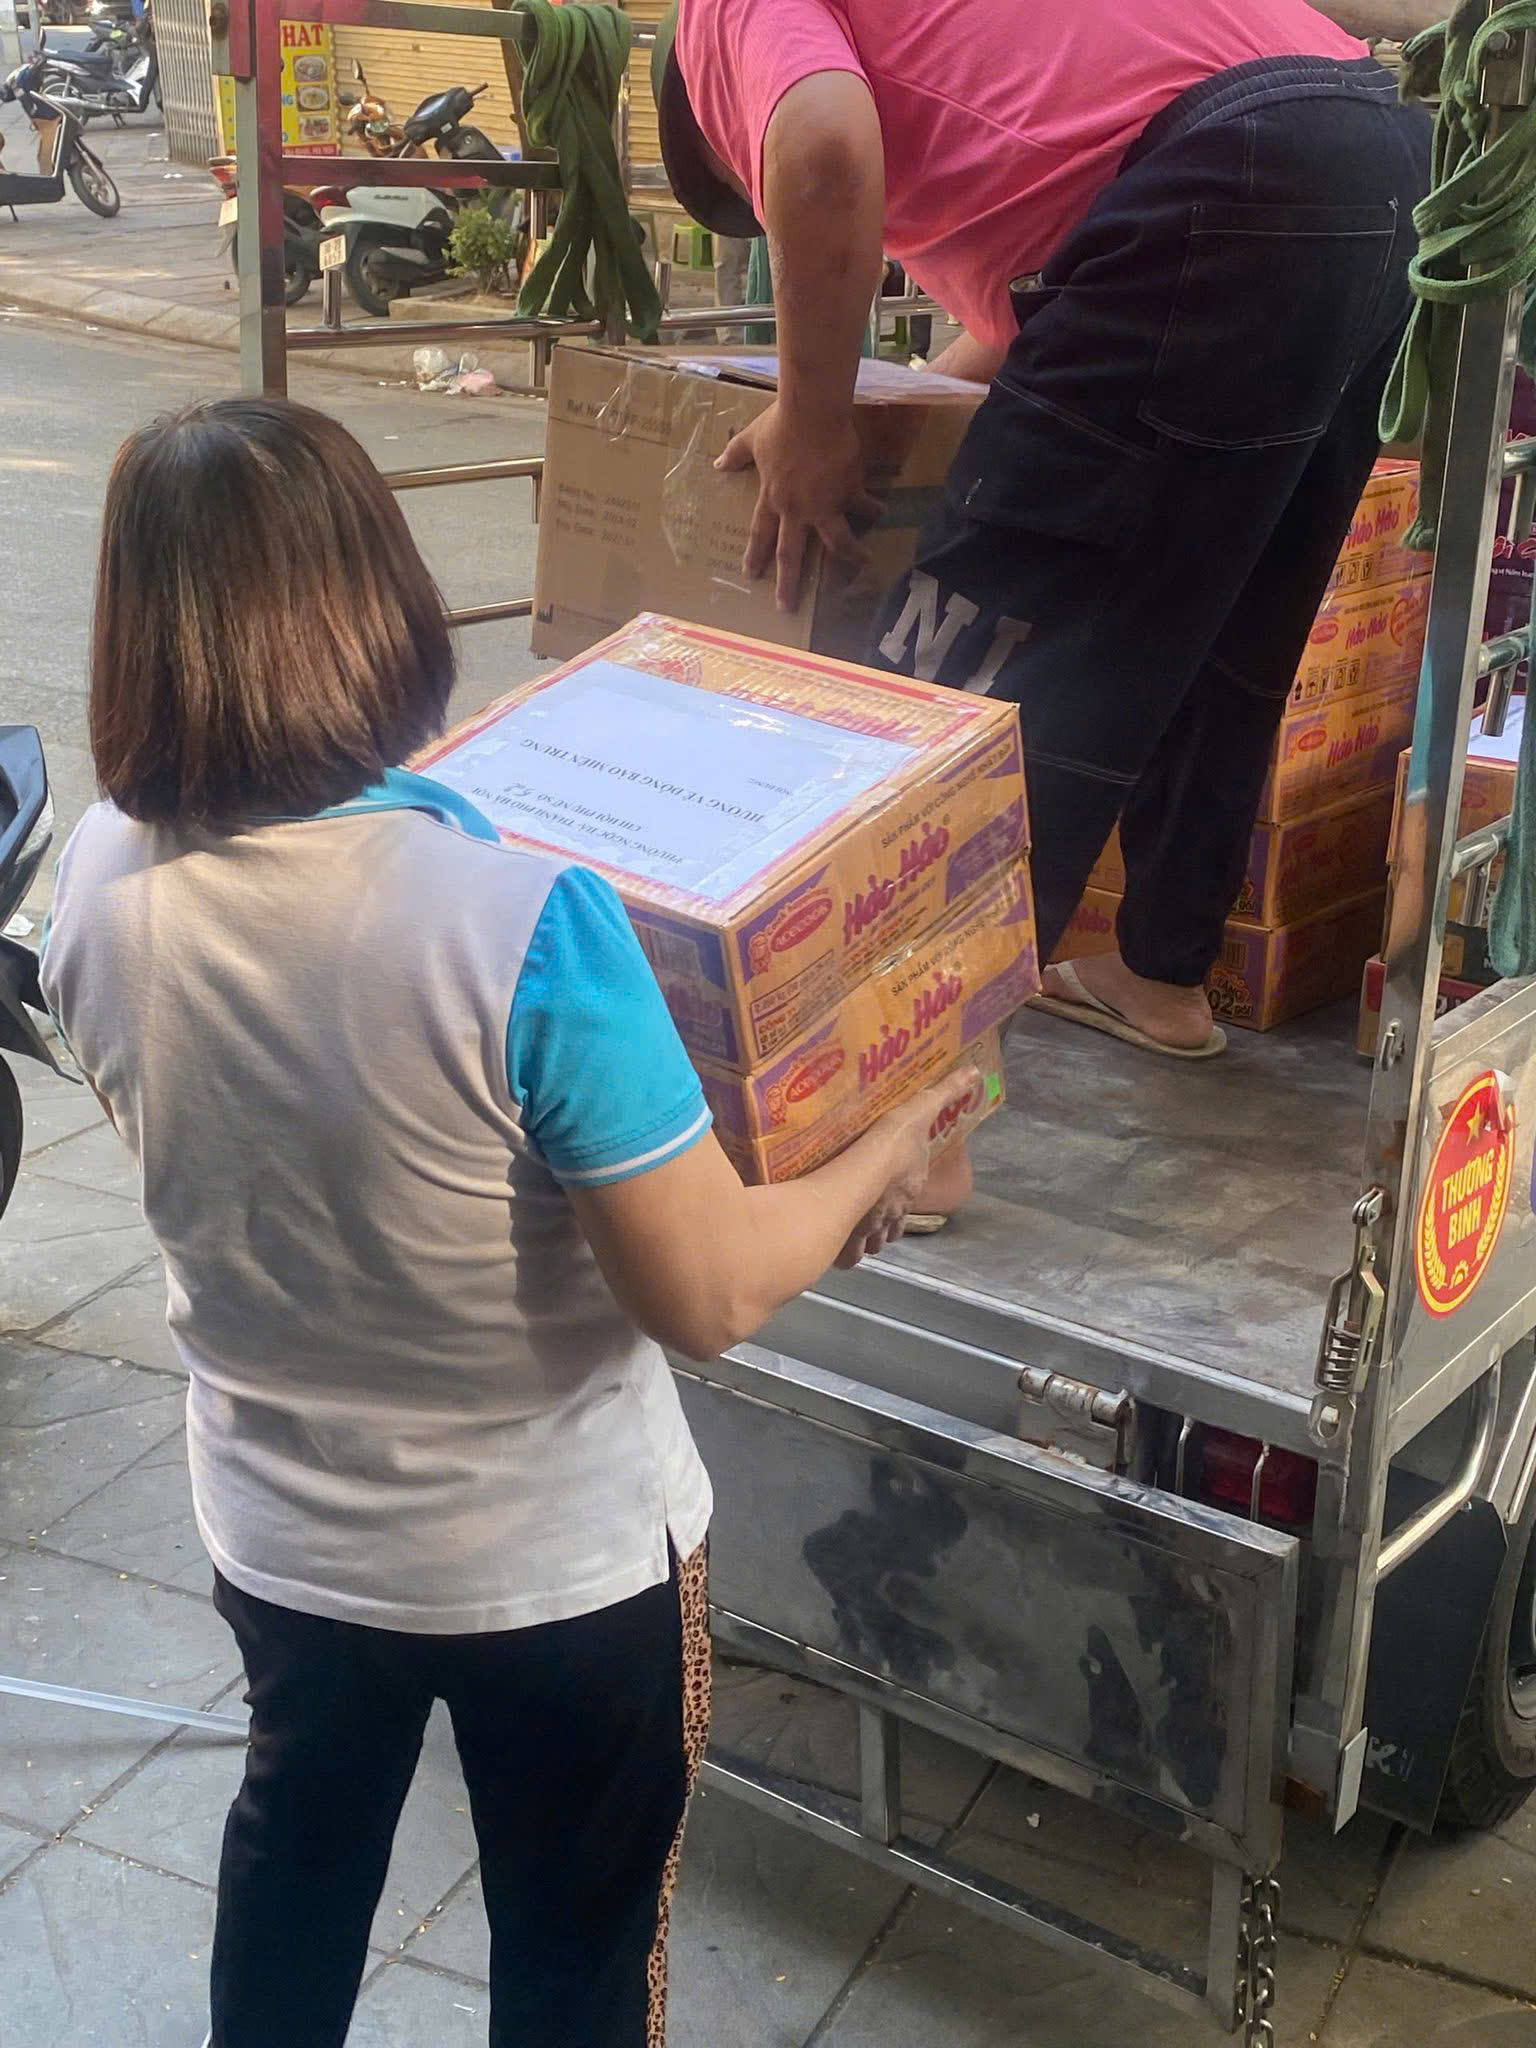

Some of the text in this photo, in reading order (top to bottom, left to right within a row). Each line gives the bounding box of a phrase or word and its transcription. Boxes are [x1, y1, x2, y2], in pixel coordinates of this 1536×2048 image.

[519, 737, 571, 761] TRUNG
[607, 765, 640, 782] BÀO
[638, 775, 684, 797] ĐỒNG
[844, 874, 897, 945] Hảo
[899, 822, 949, 892] Hảo
[859, 1024, 911, 1093] Hảo
[913, 970, 963, 1039] Hảo
[1448, 1195, 1482, 1250] BINH
